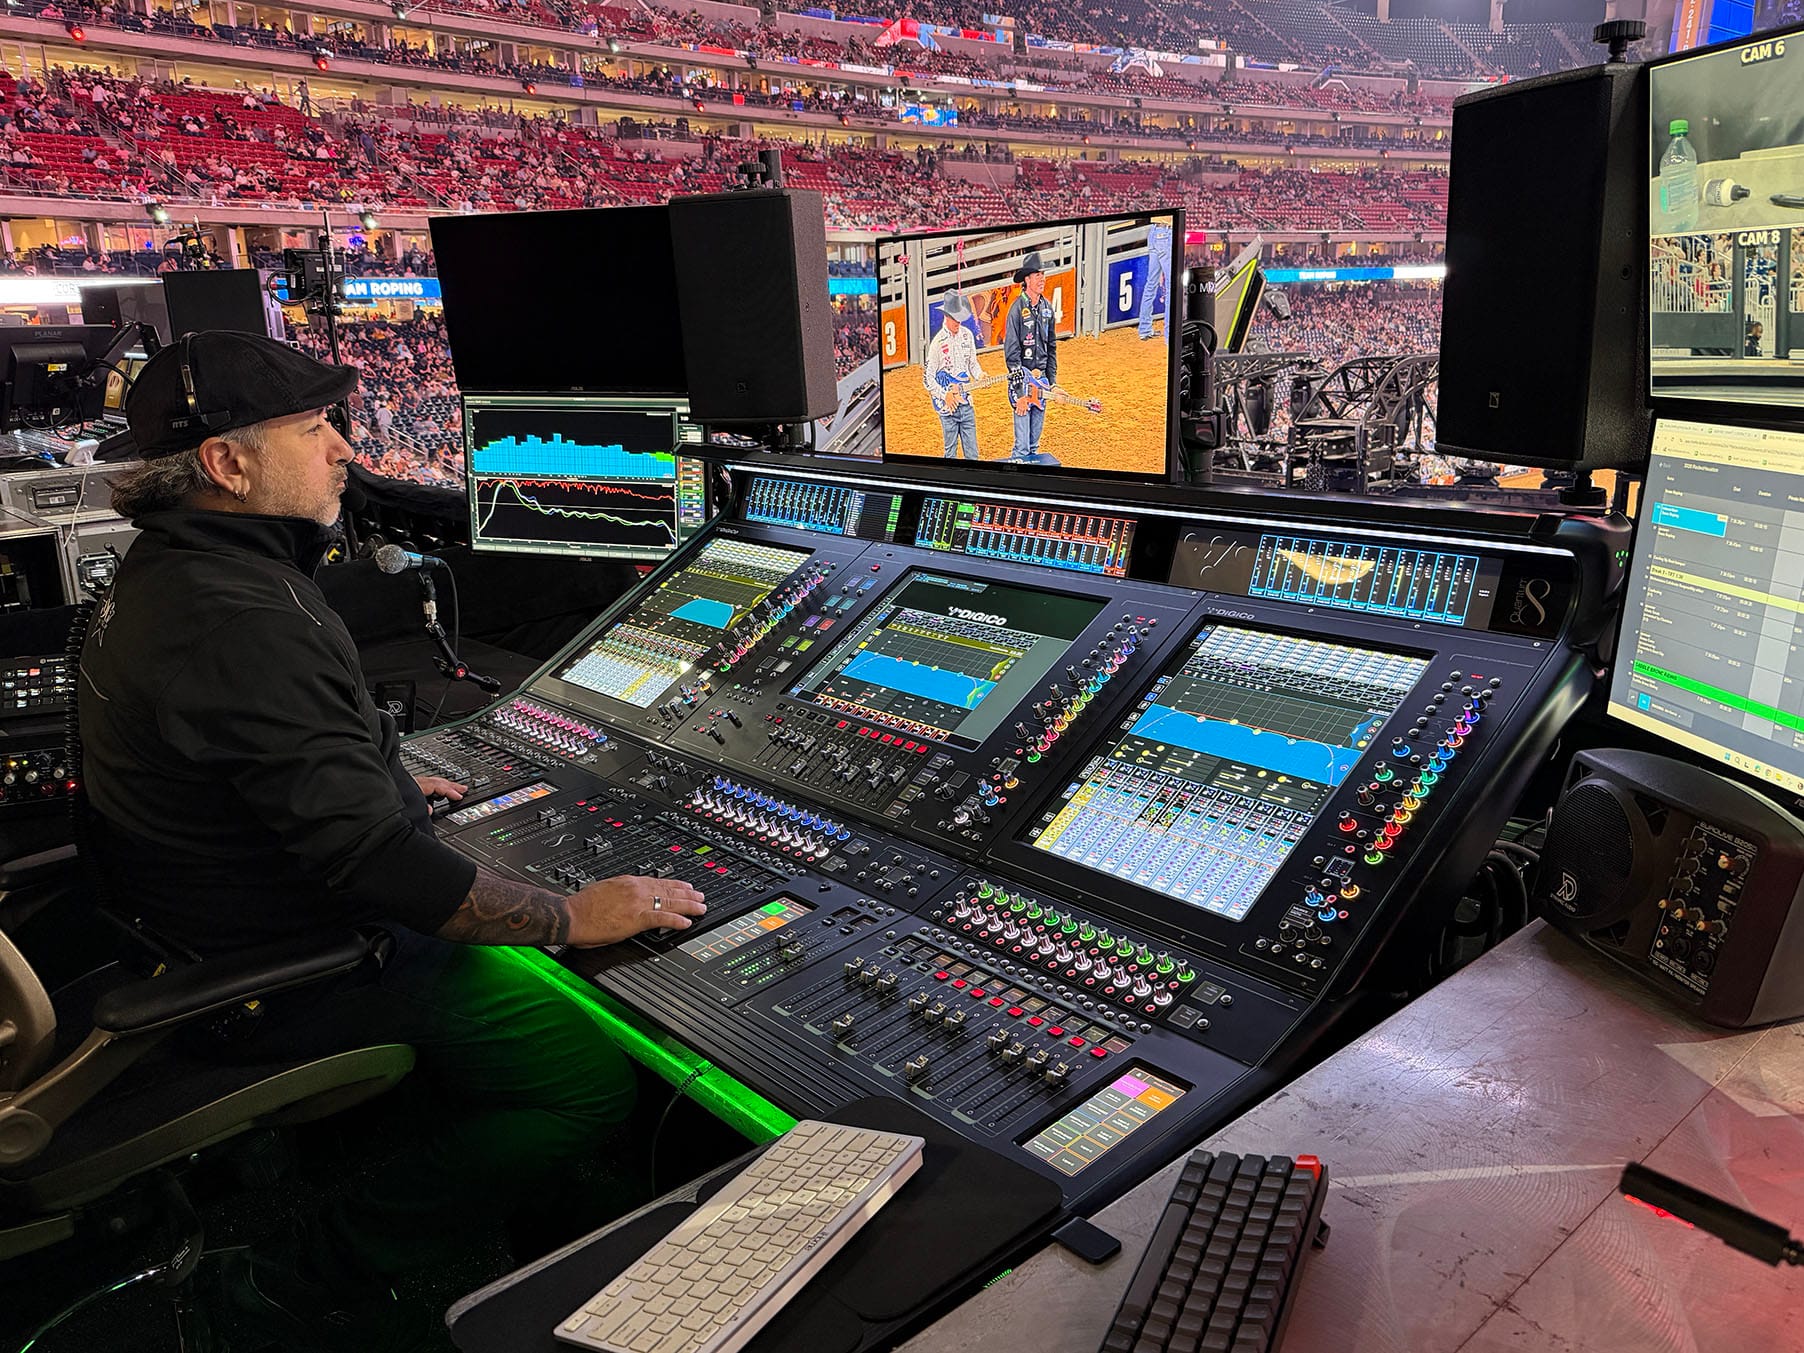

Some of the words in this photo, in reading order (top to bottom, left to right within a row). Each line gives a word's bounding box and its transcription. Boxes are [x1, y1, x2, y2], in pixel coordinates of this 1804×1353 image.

[1741, 43, 1771, 63] CAM
[1775, 40, 1785, 55] 6
[1738, 231, 1767, 246] CAM
[1771, 230, 1780, 244] 8
[345, 282, 368, 296] AM
[370, 282, 423, 296] ROPING
[1119, 272, 1133, 312] 5
[1052, 287, 1064, 324] 4
[885, 322, 896, 356] 3
